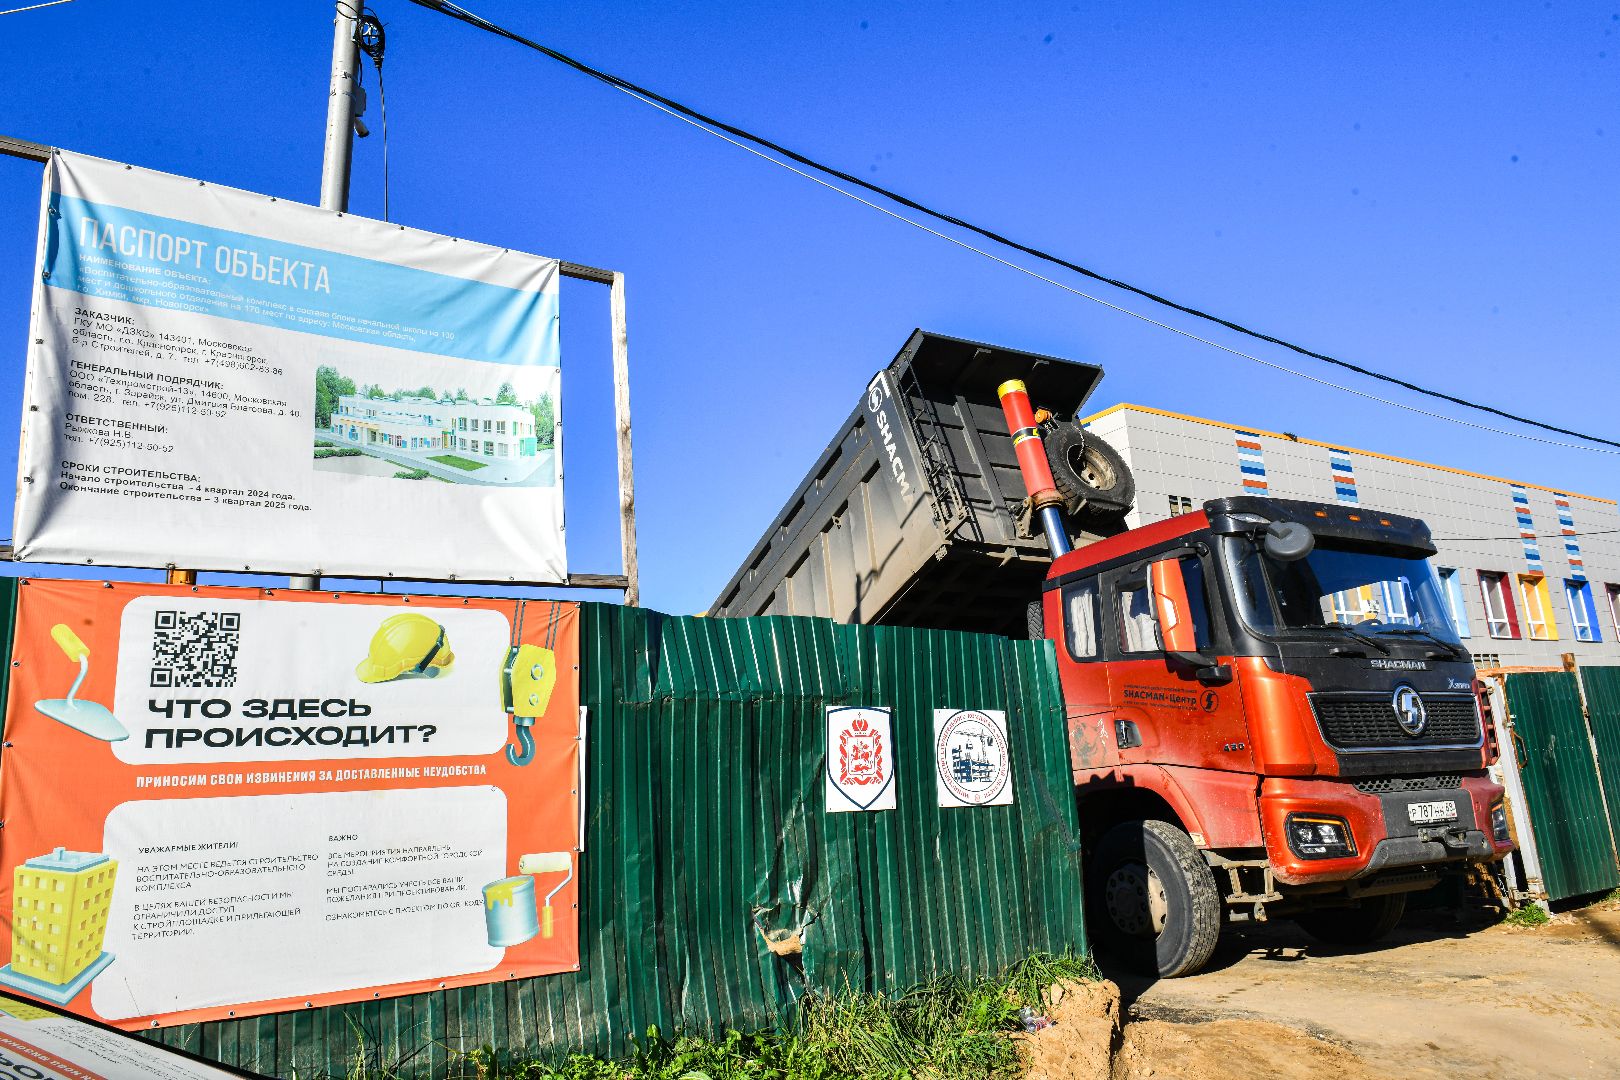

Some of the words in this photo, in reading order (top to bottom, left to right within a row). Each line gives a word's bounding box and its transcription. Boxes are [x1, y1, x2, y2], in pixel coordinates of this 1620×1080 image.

[79, 216, 208, 269] ПАСПОРТ
[215, 246, 330, 294] ОБЪЕКТА
[79, 254, 161, 275] НАИМЕНОВАНИЕ
[164, 269, 211, 284] ОБЪЕКТА:
[74, 307, 135, 325] ЗАКАЗЧИК:
[231, 303, 241, 311] на
[262, 310, 283, 318] мест
[72, 328, 116, 343] область,
[74, 317, 93, 328] ГКУ
[95, 322, 114, 332] МО
[198, 338, 253, 352] Московская
[69, 370, 95, 381] ООО
[70, 359, 154, 380] ГЕНЕРАЛЬНЫЙ
[156, 373, 224, 390] ПОДРЯДЧИК:
[68, 380, 112, 394] область,
[68, 390, 90, 400] пом.
[64, 422, 110, 437] Рыжкова
[66, 412, 168, 434] ОТВЕТСТВЕННЫЙ:
[61, 460, 100, 473] СРОКИ
[103, 466, 201, 482] СТРОИТЕЛЬСТВА:
[60, 471, 101, 483] Начало
[104, 477, 184, 491] строительства
[195, 484, 202, 492] 4
[204, 486, 244, 496] квартал
[247, 489, 270, 498] 2024
[59, 481, 120, 495] Окончание
[123, 489, 202, 502] строительства
[213, 496, 220, 504] 3
[222, 497, 261, 507] квартал
[264, 500, 286, 509] 2025
[1370, 659, 1427, 670] SHACMAN
[148, 698, 232, 719] ЧТО
[242, 698, 372, 721] ЗДЕСЬ
[144, 724, 438, 749] ПРОИСХОДИТ?
[136, 774, 207, 788] ПРИНОСИМ
[210, 773, 243, 786] СВОИ
[246, 770, 316, 784] ИЗВИНЕНИЯ
[319, 770, 333, 781] ЗА
[335, 767, 420, 782] ДОСТАВЛЕННЫЕ
[423, 764, 487, 778] НЕУДОБСТВА
[328, 834, 359, 842] ВАЖНО
[138, 844, 196, 854] УВАЖАЕМЫЕ
[152, 863, 178, 873] ЭТОМ
[180, 861, 209, 870] МЕСТЕ
[249, 854, 319, 865] СТРОИТЕЛЬСТВО
[135, 881, 192, 893] КОМПЛЕКСА
[134, 904, 140, 912] В
[142, 902, 172, 912] ЦЕЛЯХ
[208, 893, 270, 905] БЕЗОПАСНОСТИ
[271, 892, 278, 900] И
[133, 909, 197, 921] ОГРАНИЧИЛИ
[198, 905, 235, 916] ДОСТУП
[133, 923, 139, 931] К
[234, 907, 301, 922] ПРИЛЕГАЮЩЕЙ
